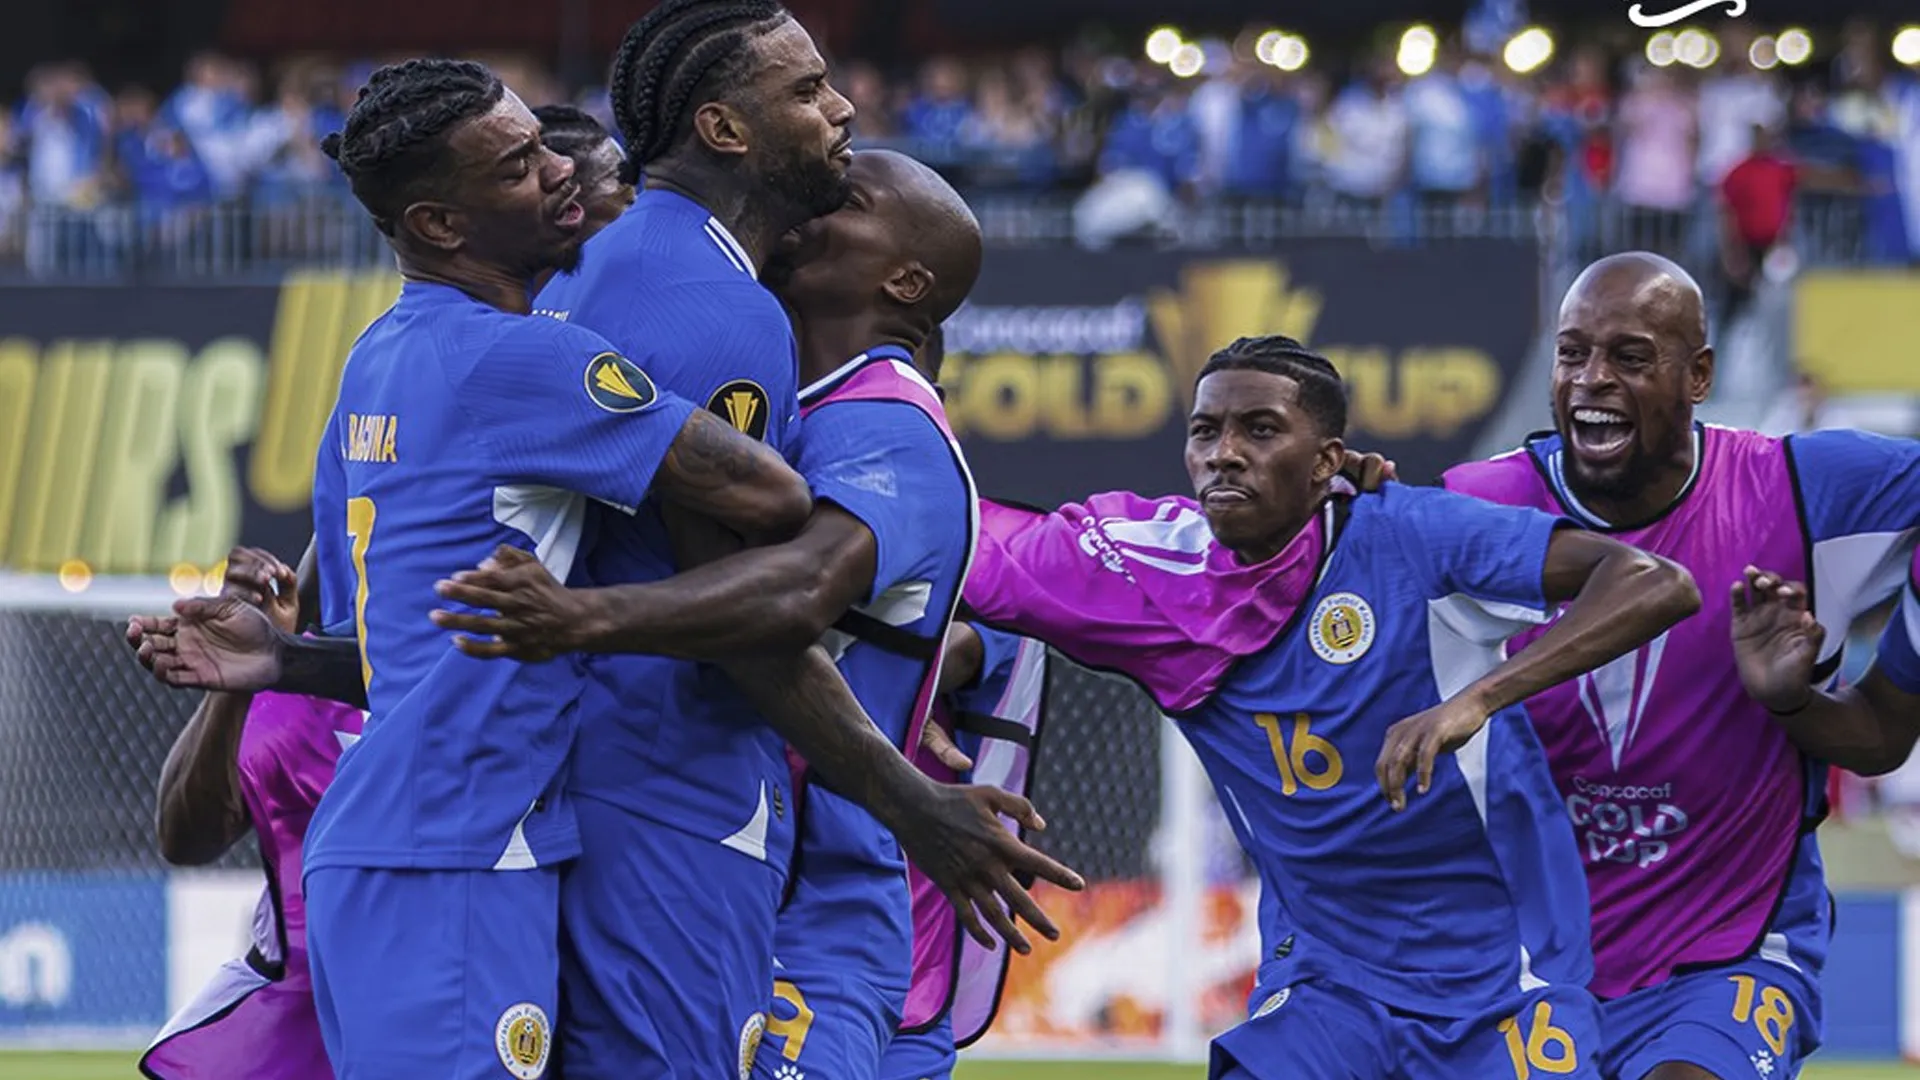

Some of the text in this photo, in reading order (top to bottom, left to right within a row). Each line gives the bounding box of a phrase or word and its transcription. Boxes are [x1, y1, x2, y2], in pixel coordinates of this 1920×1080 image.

[1253, 711, 1343, 796] 16
[1566, 794, 1688, 836] GOLD
[1573, 775, 1671, 799] Concacaf
[1585, 830, 1668, 868] CUP
[1497, 1001, 1577, 1080] 16
[1728, 975, 1794, 1055] 18
